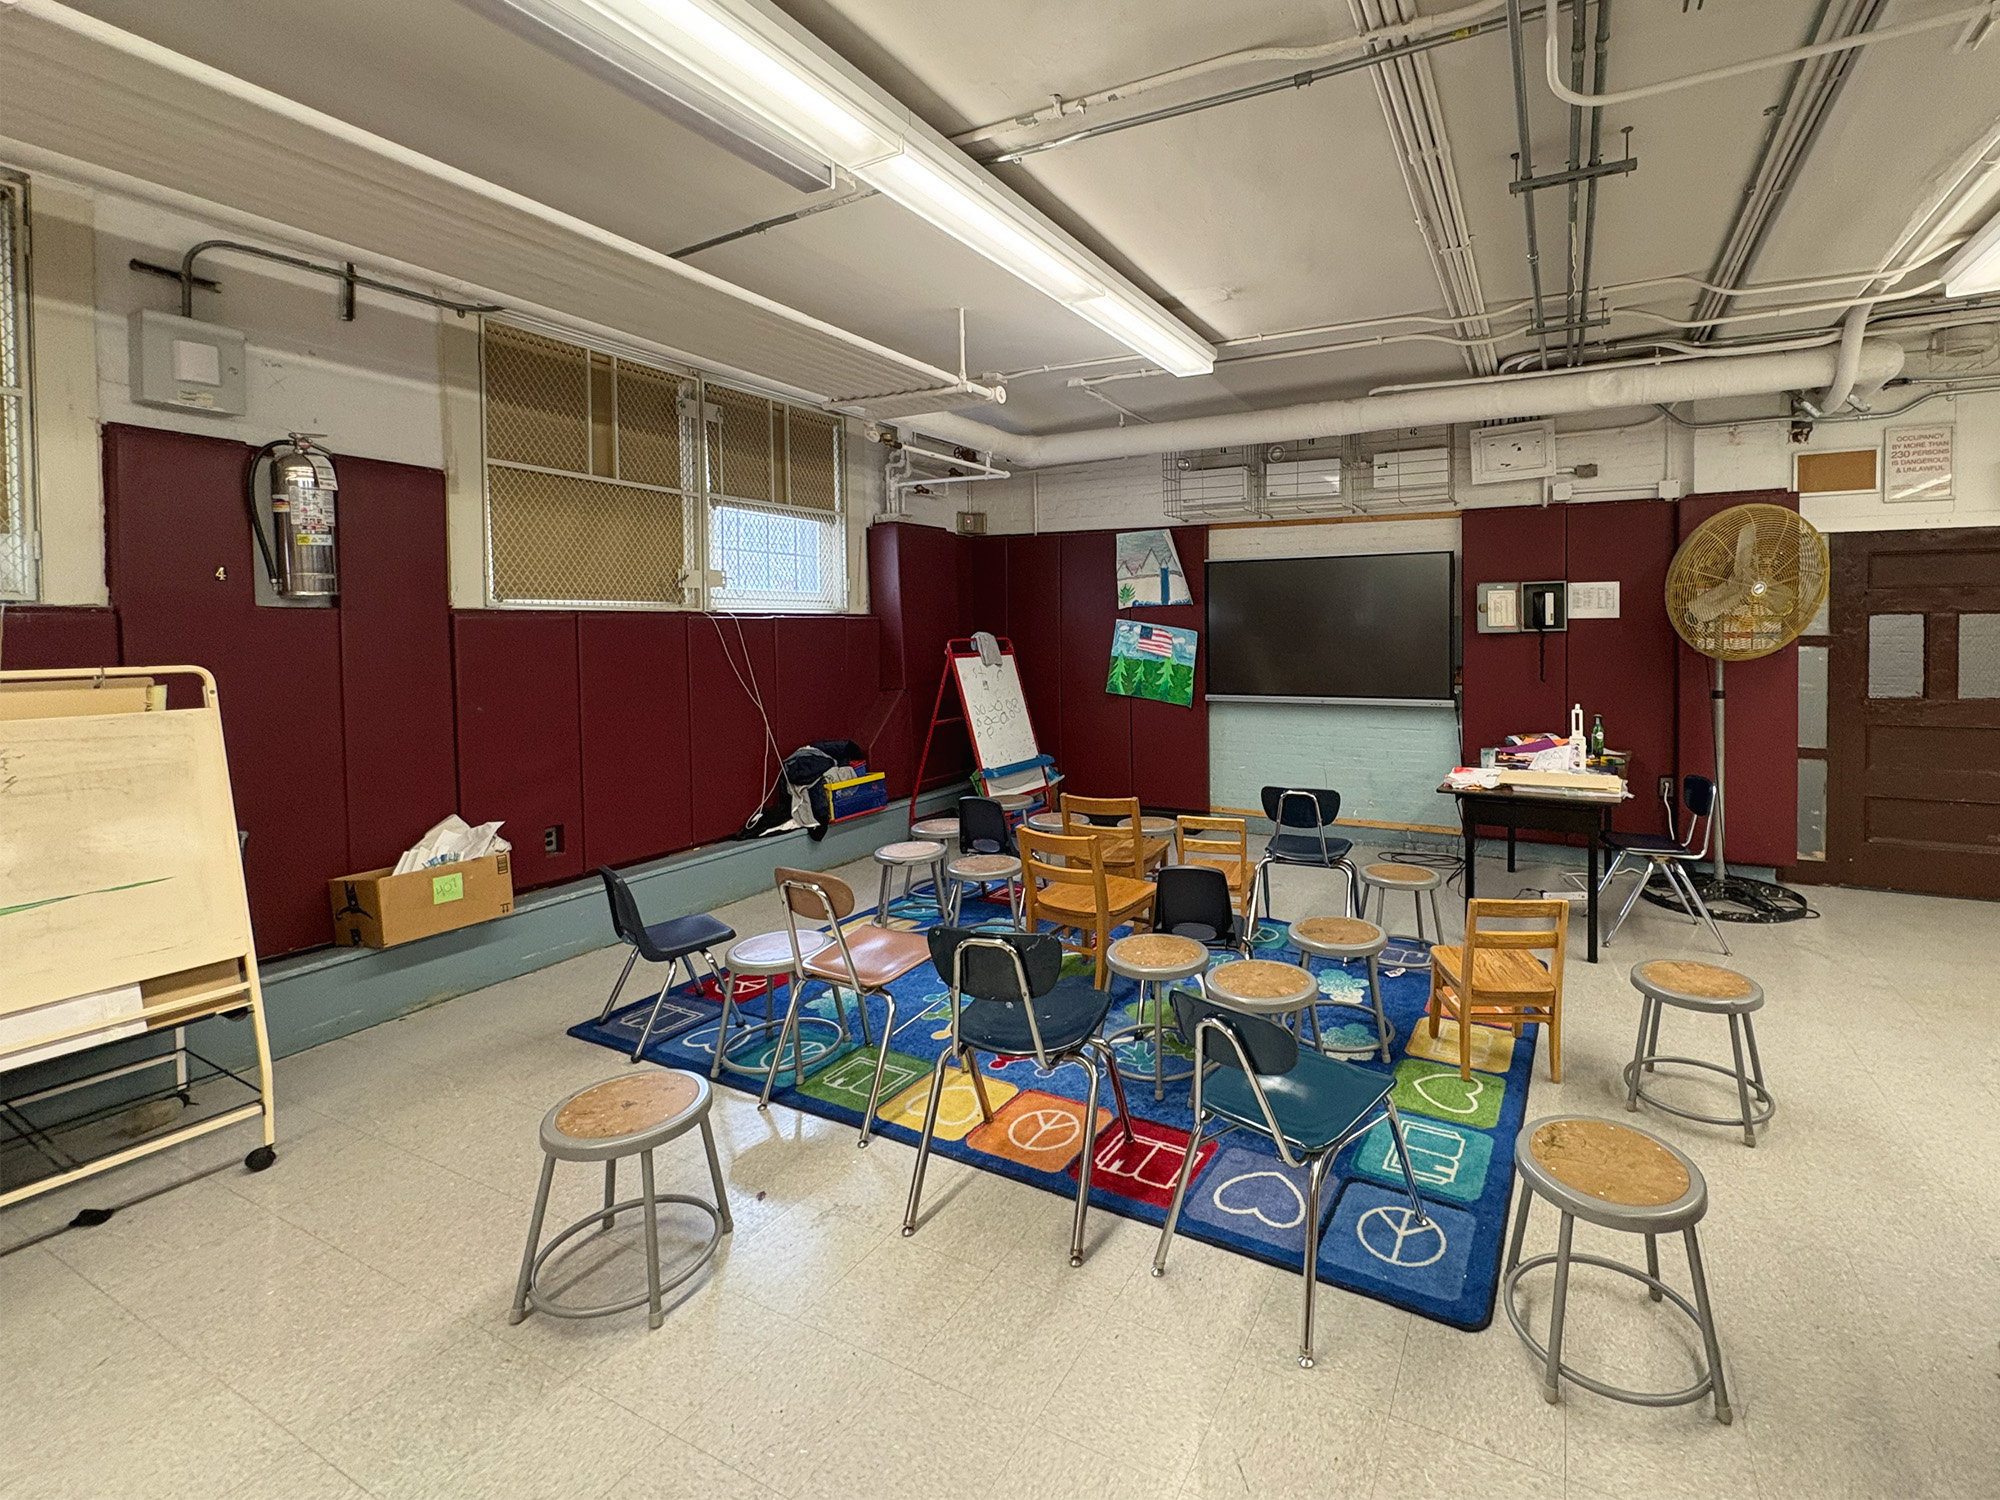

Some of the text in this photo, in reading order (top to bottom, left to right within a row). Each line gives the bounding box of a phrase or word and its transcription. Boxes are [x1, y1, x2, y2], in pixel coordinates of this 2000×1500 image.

[1896, 433, 1945, 442] OCCUPANCY
[1891, 448, 1950, 459] 230 PERSONS
[1900, 457, 1950, 466] DANGEROUS
[1903, 465, 1945, 473] UNLAWFUL
[215, 566, 227, 581] 4
